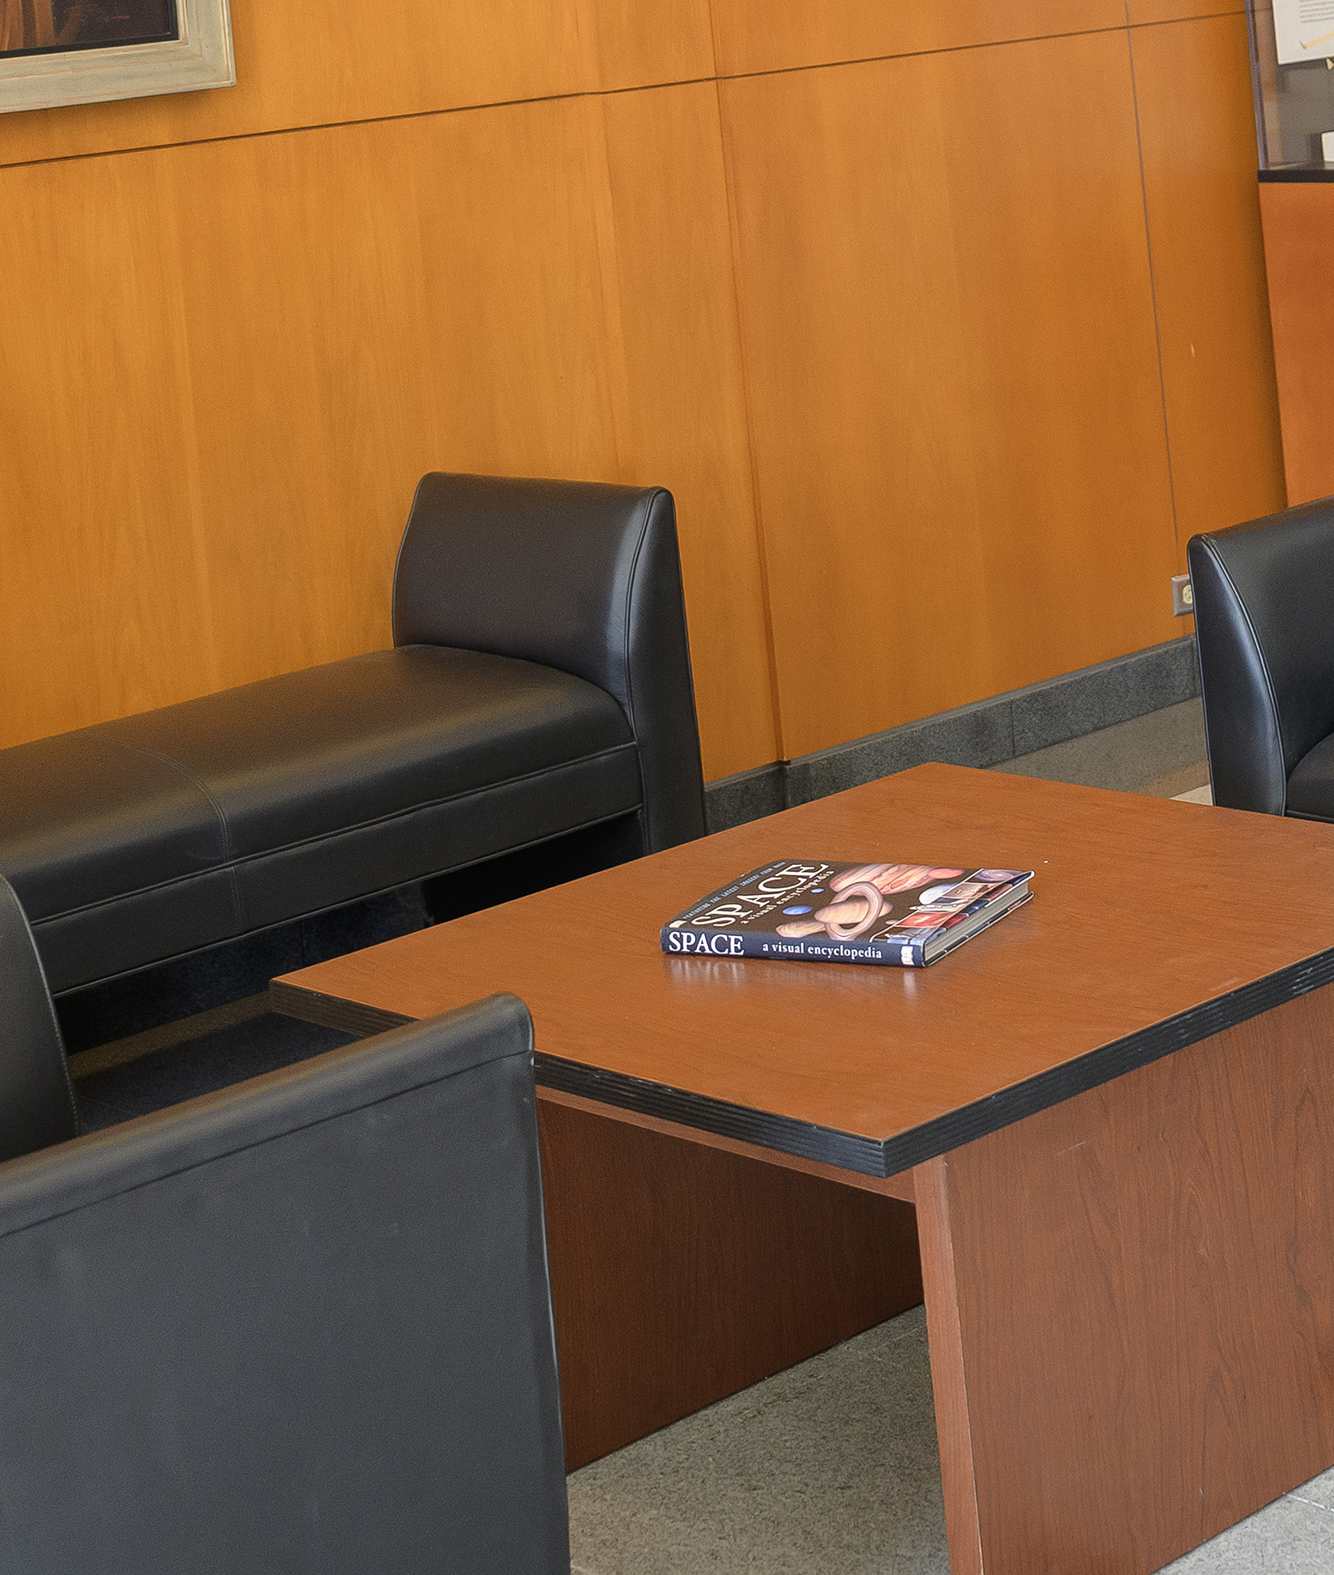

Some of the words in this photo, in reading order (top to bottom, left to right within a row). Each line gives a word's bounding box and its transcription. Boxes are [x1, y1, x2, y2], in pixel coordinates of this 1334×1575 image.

[691, 864, 829, 927] SPACE
[668, 931, 744, 956] SPACE
[762, 942, 769, 952] a
[771, 941, 805, 954] visual
[807, 945, 883, 960] encyclopedia
